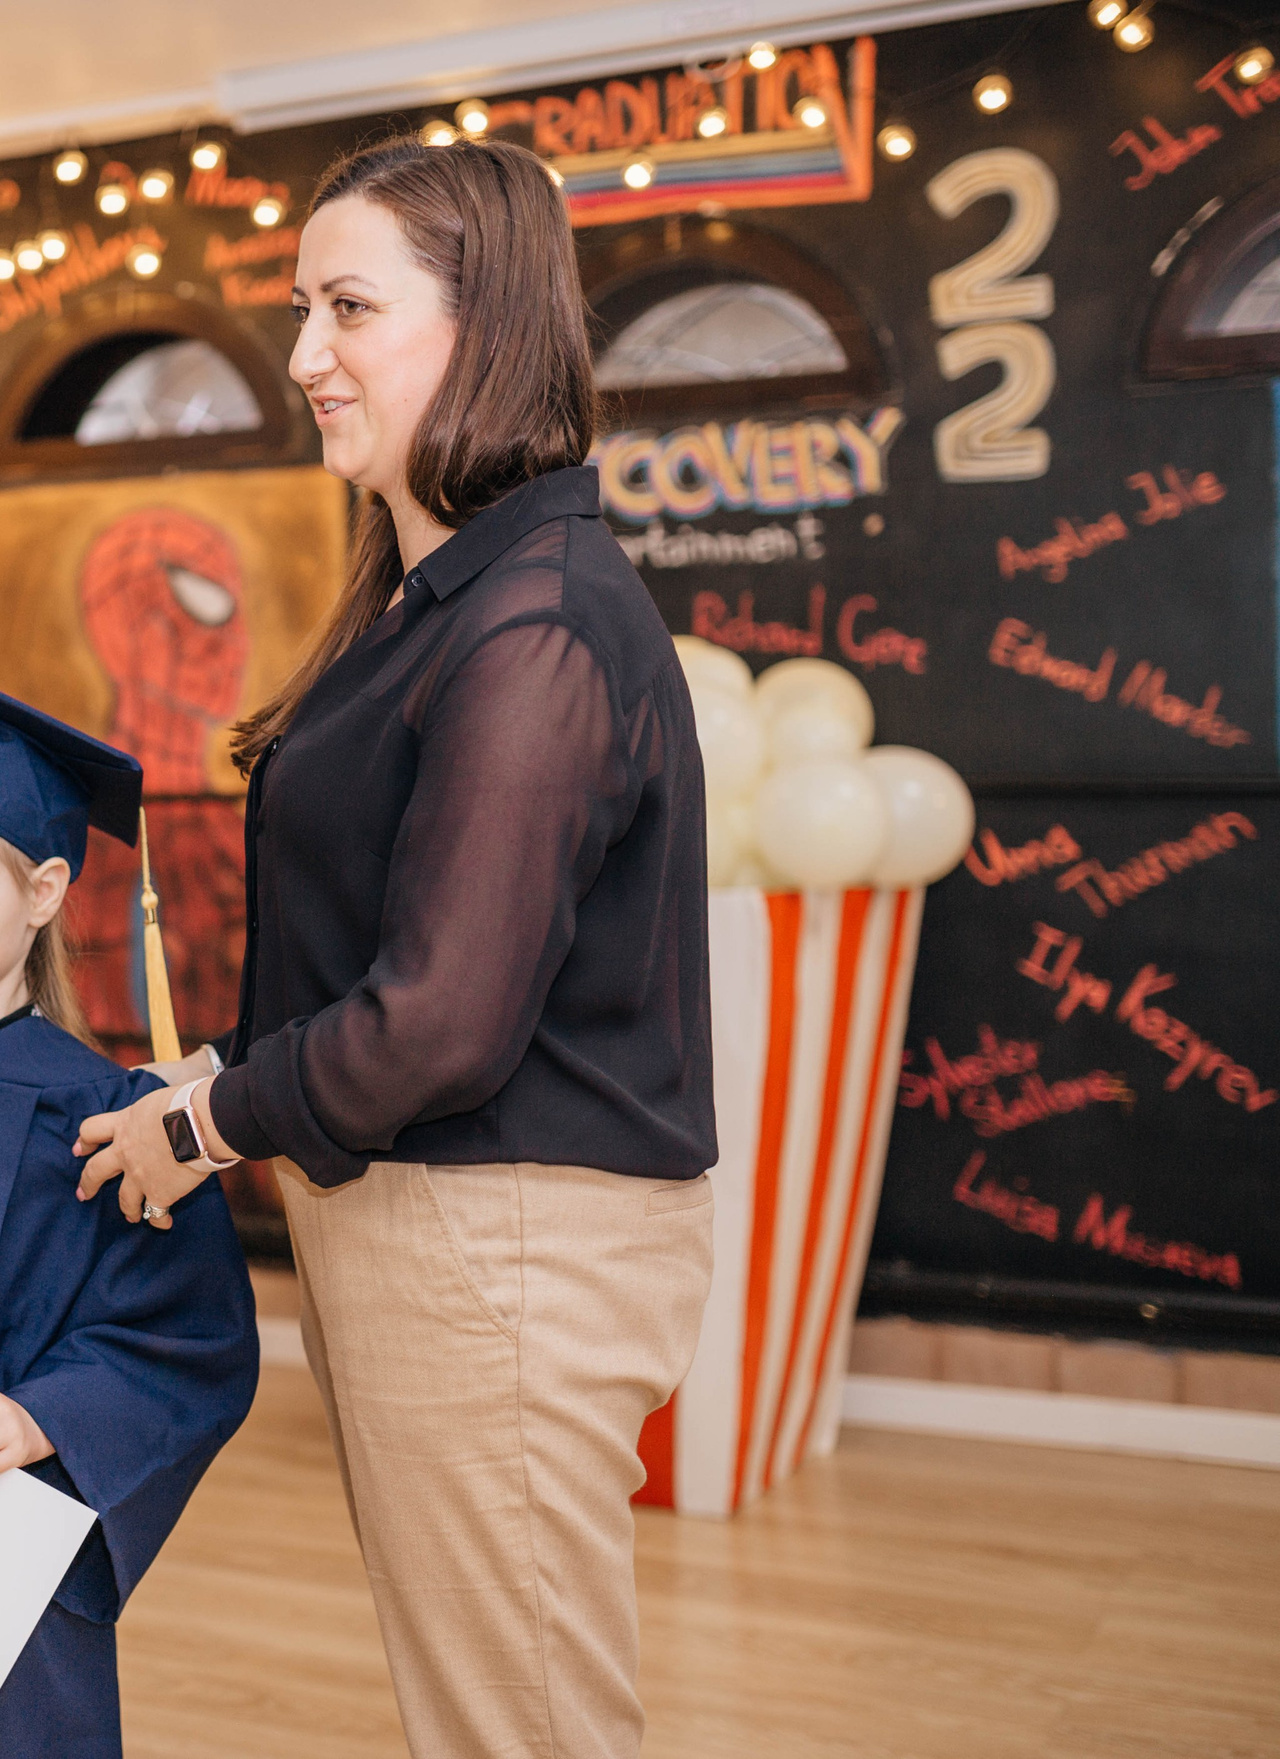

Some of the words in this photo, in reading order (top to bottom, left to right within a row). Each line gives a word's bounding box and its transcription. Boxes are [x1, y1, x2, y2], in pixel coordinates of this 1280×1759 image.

[926, 147, 1060, 326] 2
[934, 318, 1058, 483] 2
[586, 405, 906, 525] COVERY
[614, 510, 826, 569] rtainment
[964, 823, 1082, 887] Uma
